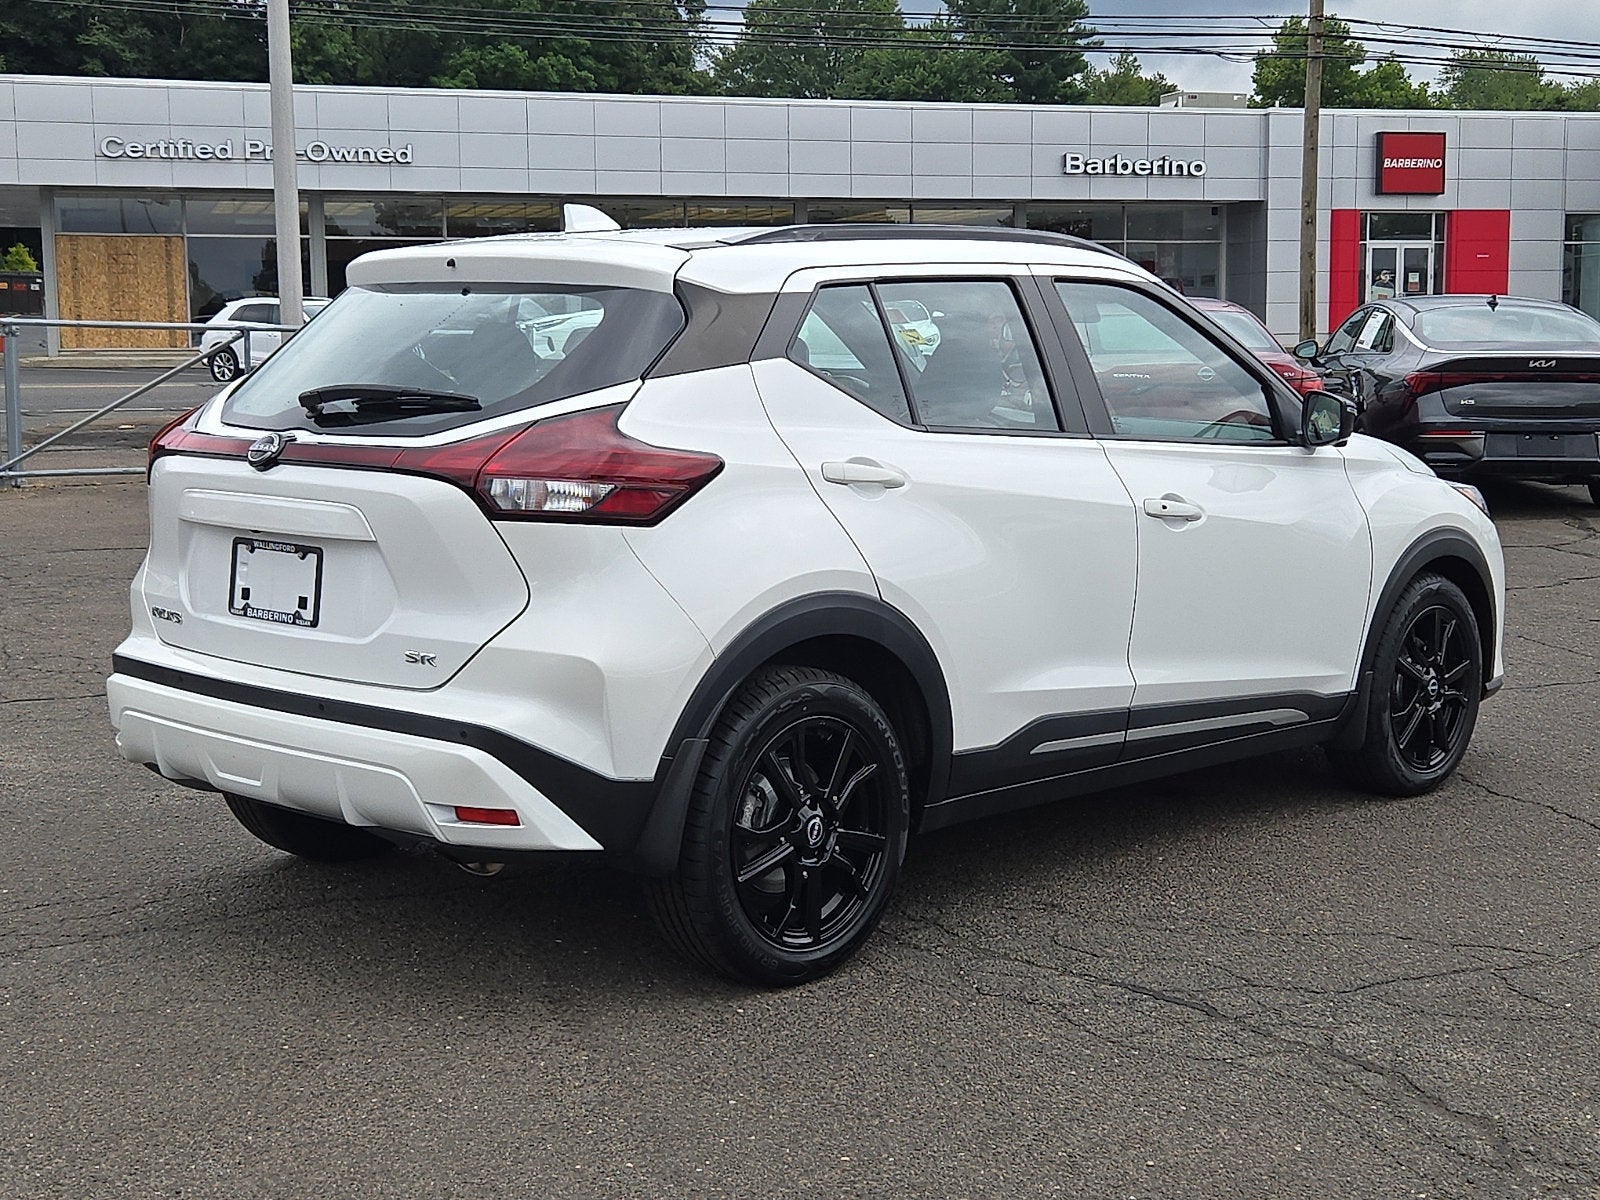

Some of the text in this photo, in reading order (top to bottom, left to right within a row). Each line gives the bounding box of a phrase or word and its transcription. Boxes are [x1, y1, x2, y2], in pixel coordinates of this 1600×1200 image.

[100, 136, 413, 163] Certified Pr-Owned
[1063, 152, 1208, 176] Barberino
[1383, 158, 1443, 168] BARBERINO
[253, 541, 296, 553] WALLINGFORD
[247, 608, 294, 624] BARBERINO
[404, 649, 437, 668] SR
[860, 704, 909, 815] ARROYO
